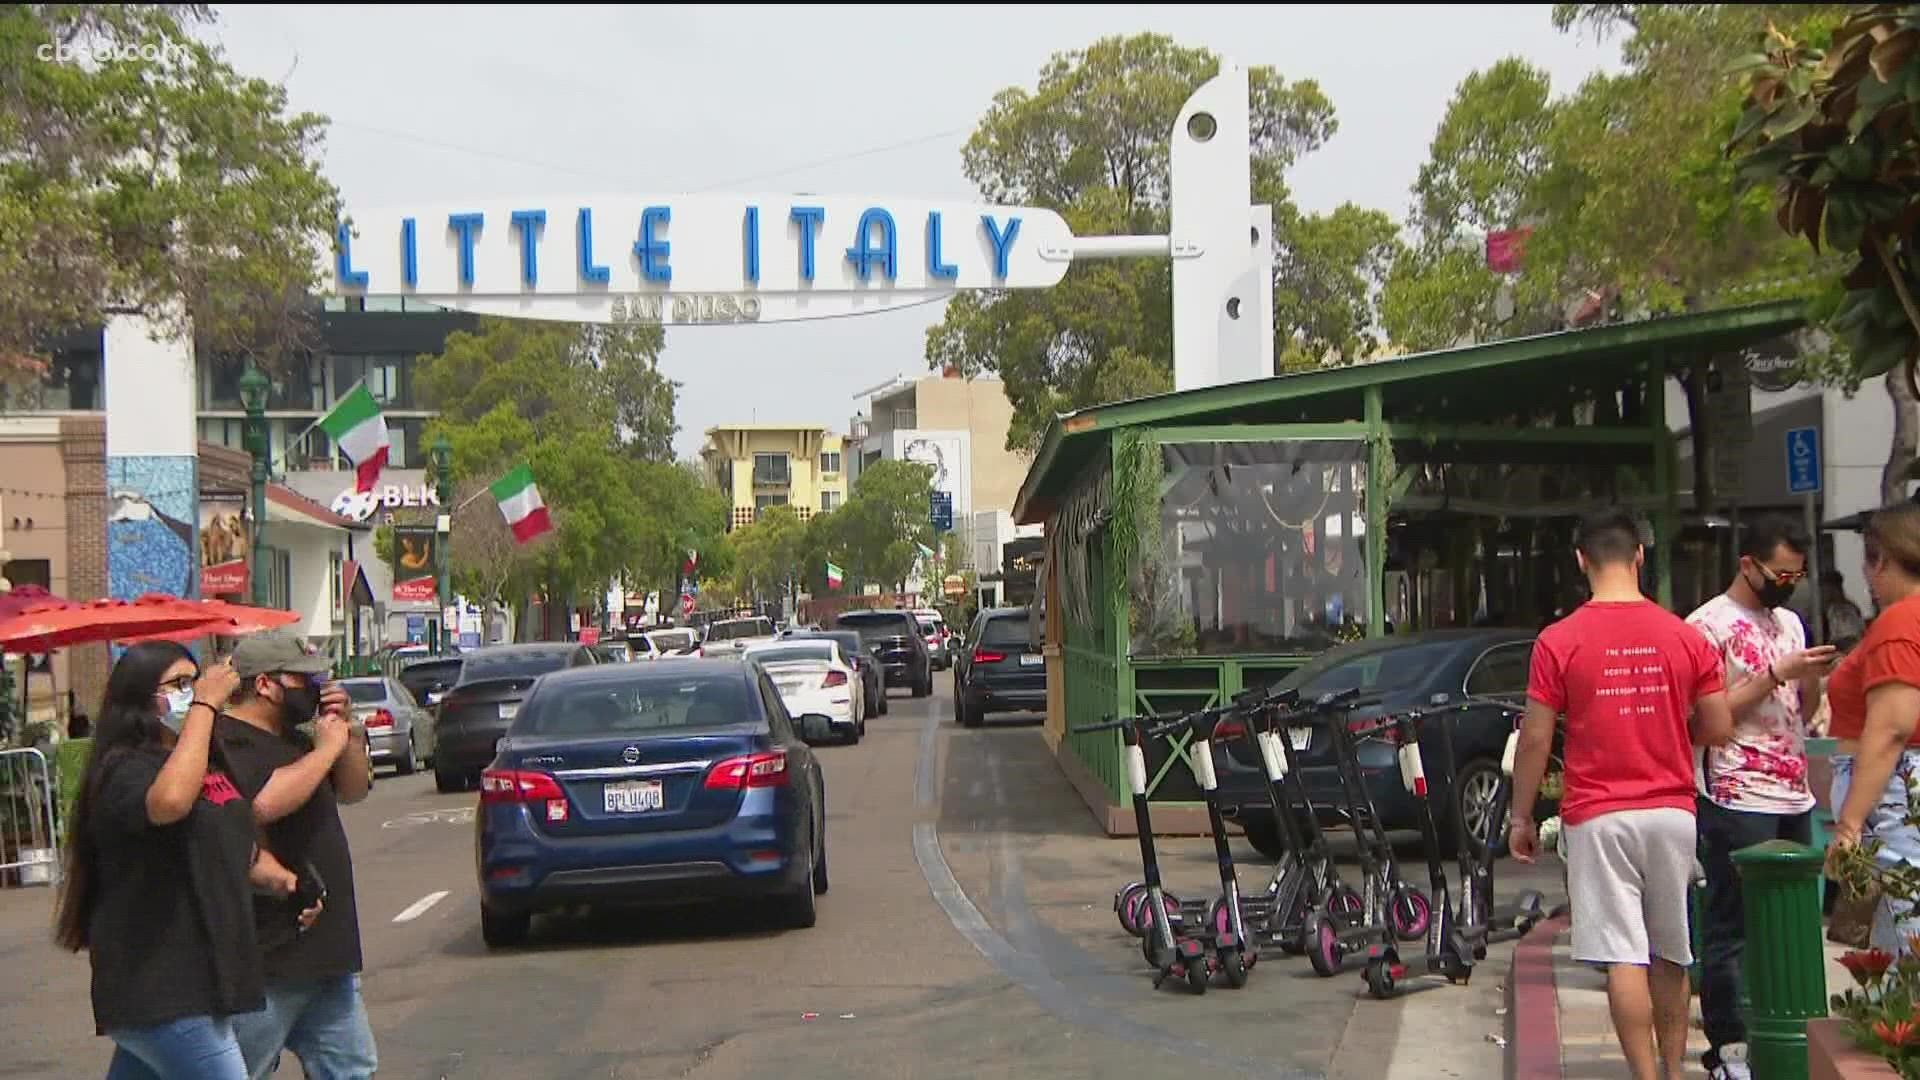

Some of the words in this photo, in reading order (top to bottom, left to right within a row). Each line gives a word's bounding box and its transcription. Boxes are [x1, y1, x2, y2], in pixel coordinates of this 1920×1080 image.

[336, 205, 672, 288] LITTLE
[744, 205, 1023, 282] ITALY
[611, 296, 664, 321] SAN
[672, 295, 761, 321] DIEGO
